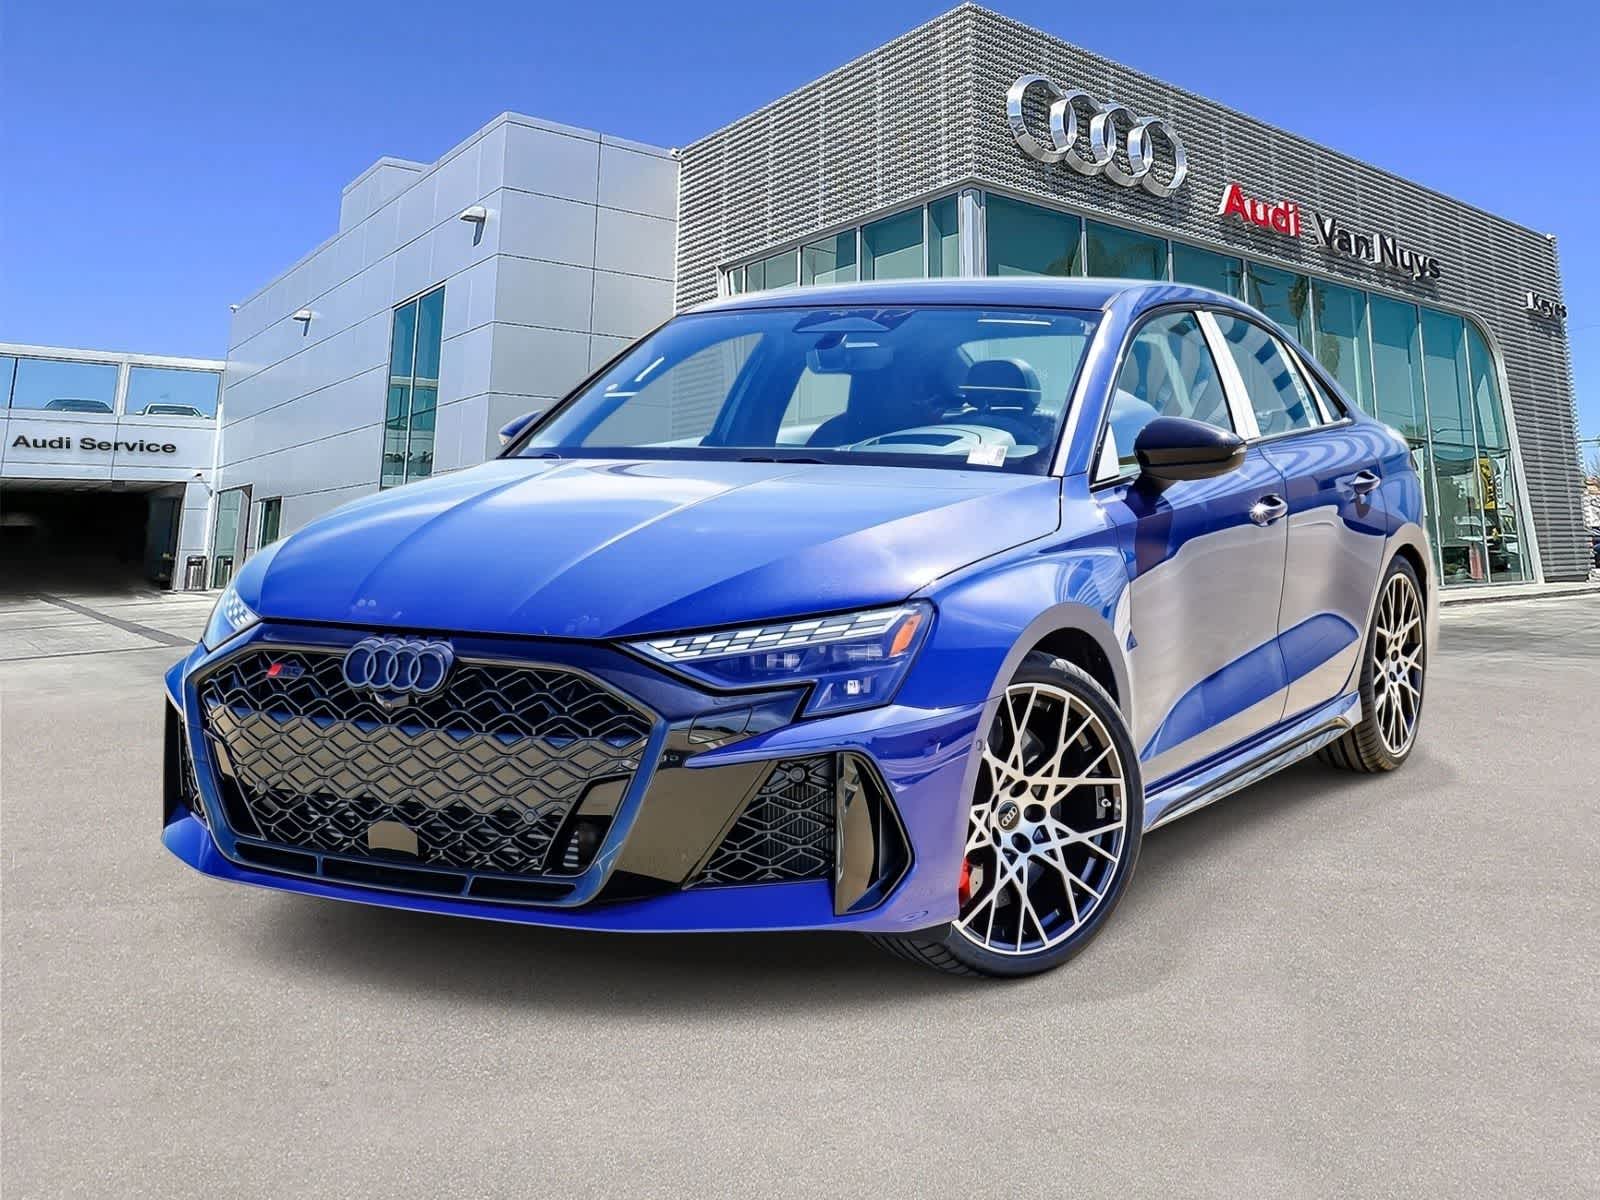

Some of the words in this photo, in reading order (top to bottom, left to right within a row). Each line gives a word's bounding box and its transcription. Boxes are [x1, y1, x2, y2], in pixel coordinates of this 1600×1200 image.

[1219, 182, 1301, 238] Audi
[1311, 213, 1370, 260] Van
[1374, 233, 1441, 280] Nuys
[12, 435, 71, 449] Audi
[79, 437, 177, 454] Service
